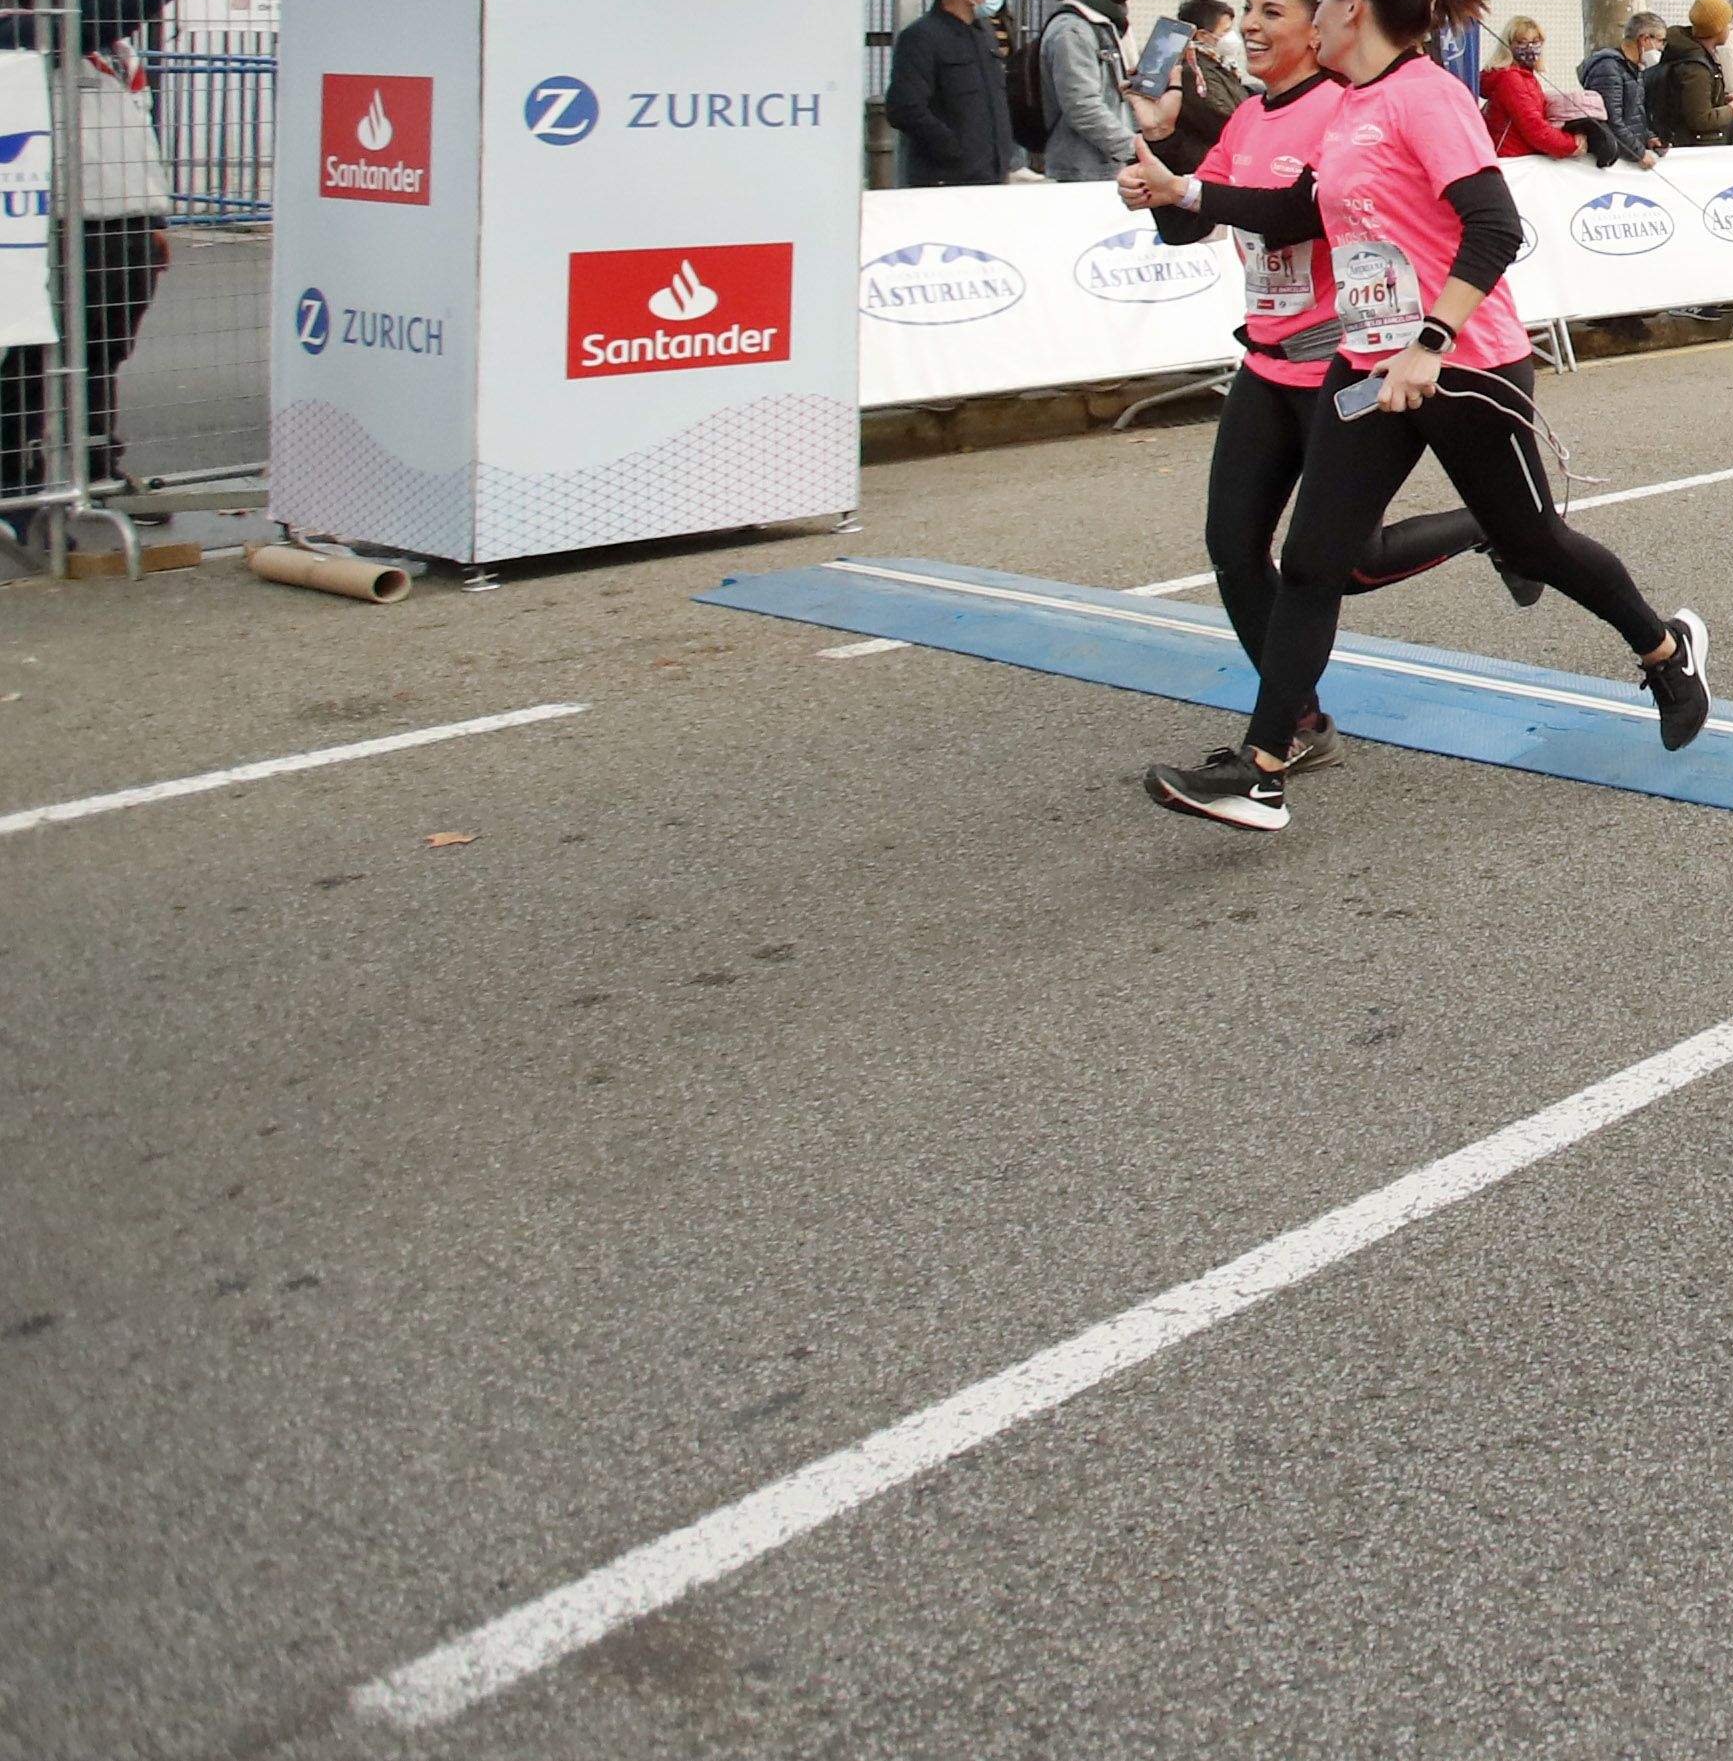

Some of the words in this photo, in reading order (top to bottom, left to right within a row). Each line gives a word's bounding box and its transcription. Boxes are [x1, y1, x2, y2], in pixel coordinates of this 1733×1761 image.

[626, 93, 821, 128] ZURICH
[326, 156, 424, 193] Santander
[1580, 218, 1669, 242] ASTURIANA
[1090, 260, 1216, 289] ASTURIANA
[866, 277, 1016, 308] ASTURIANA
[1349, 283, 1386, 307] 016
[342, 309, 444, 357] ZURICH
[581, 323, 778, 368] Santander
